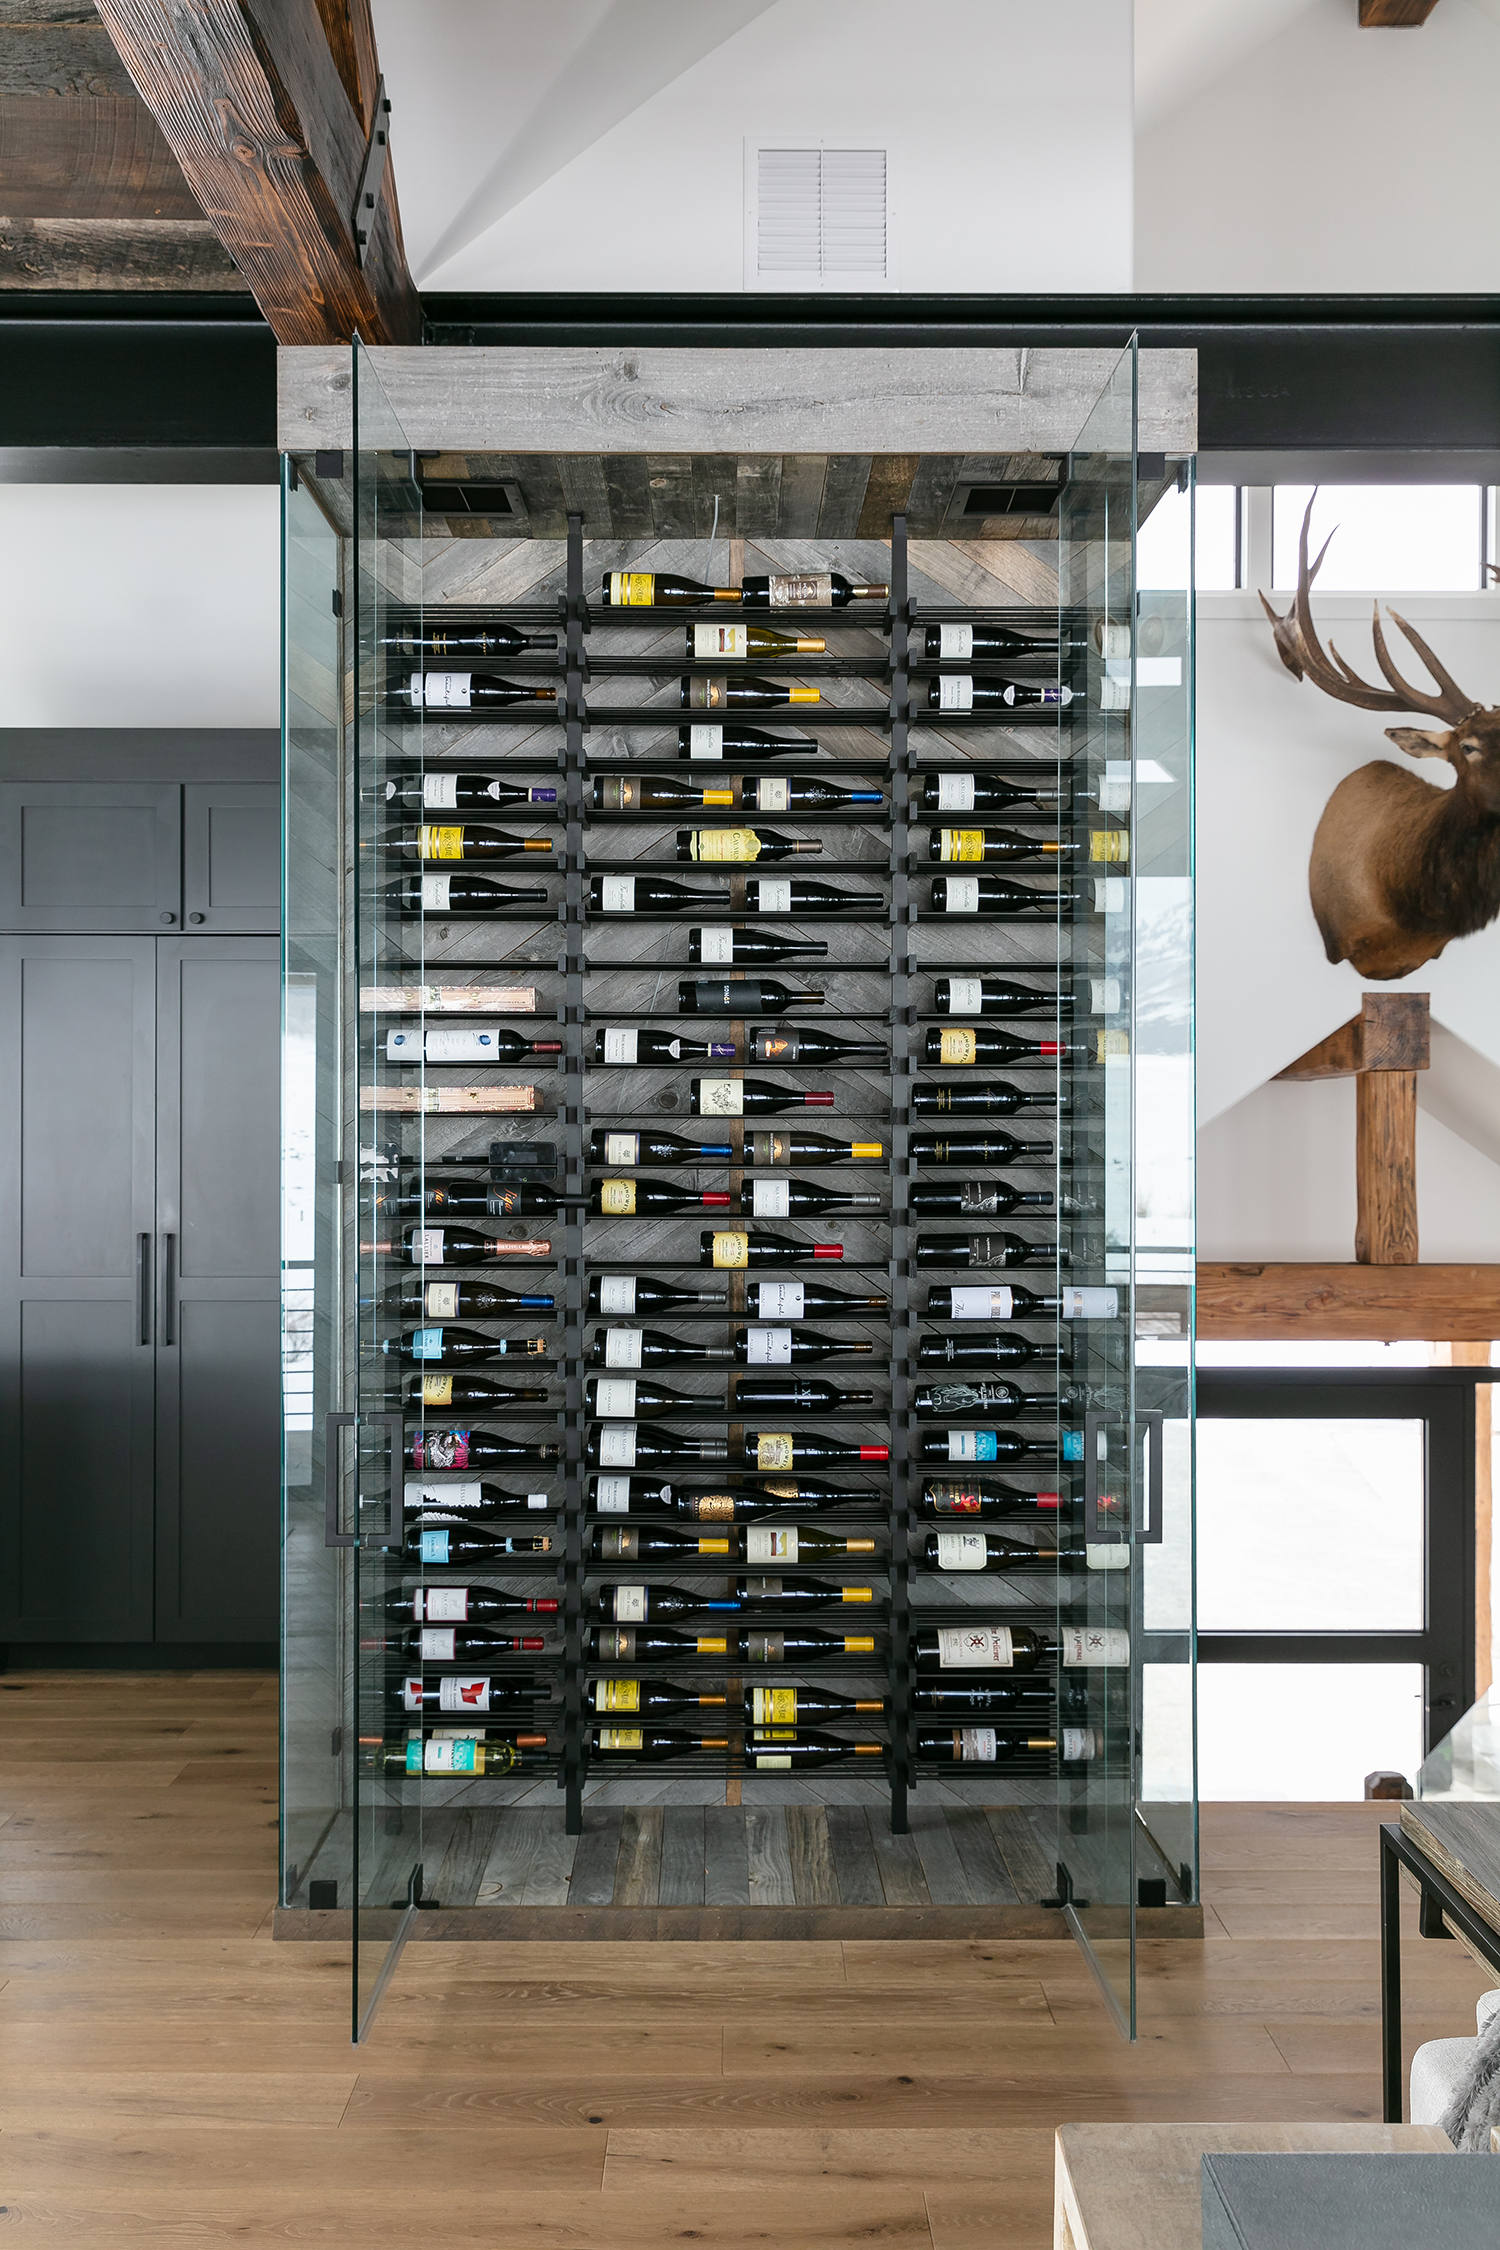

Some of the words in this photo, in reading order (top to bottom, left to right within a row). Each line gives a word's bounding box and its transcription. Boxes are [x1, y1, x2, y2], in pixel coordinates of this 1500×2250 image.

[732, 832, 740, 860] CAYMUS
[960, 1030, 970, 1063] CHENOWETH
[620, 1180, 630, 1213] CHENOWETH
[732, 1232, 742, 1266] CHENOWETH
[436, 1376, 447, 1397] OWETH
[778, 1436, 789, 1469] CHENOWETH
